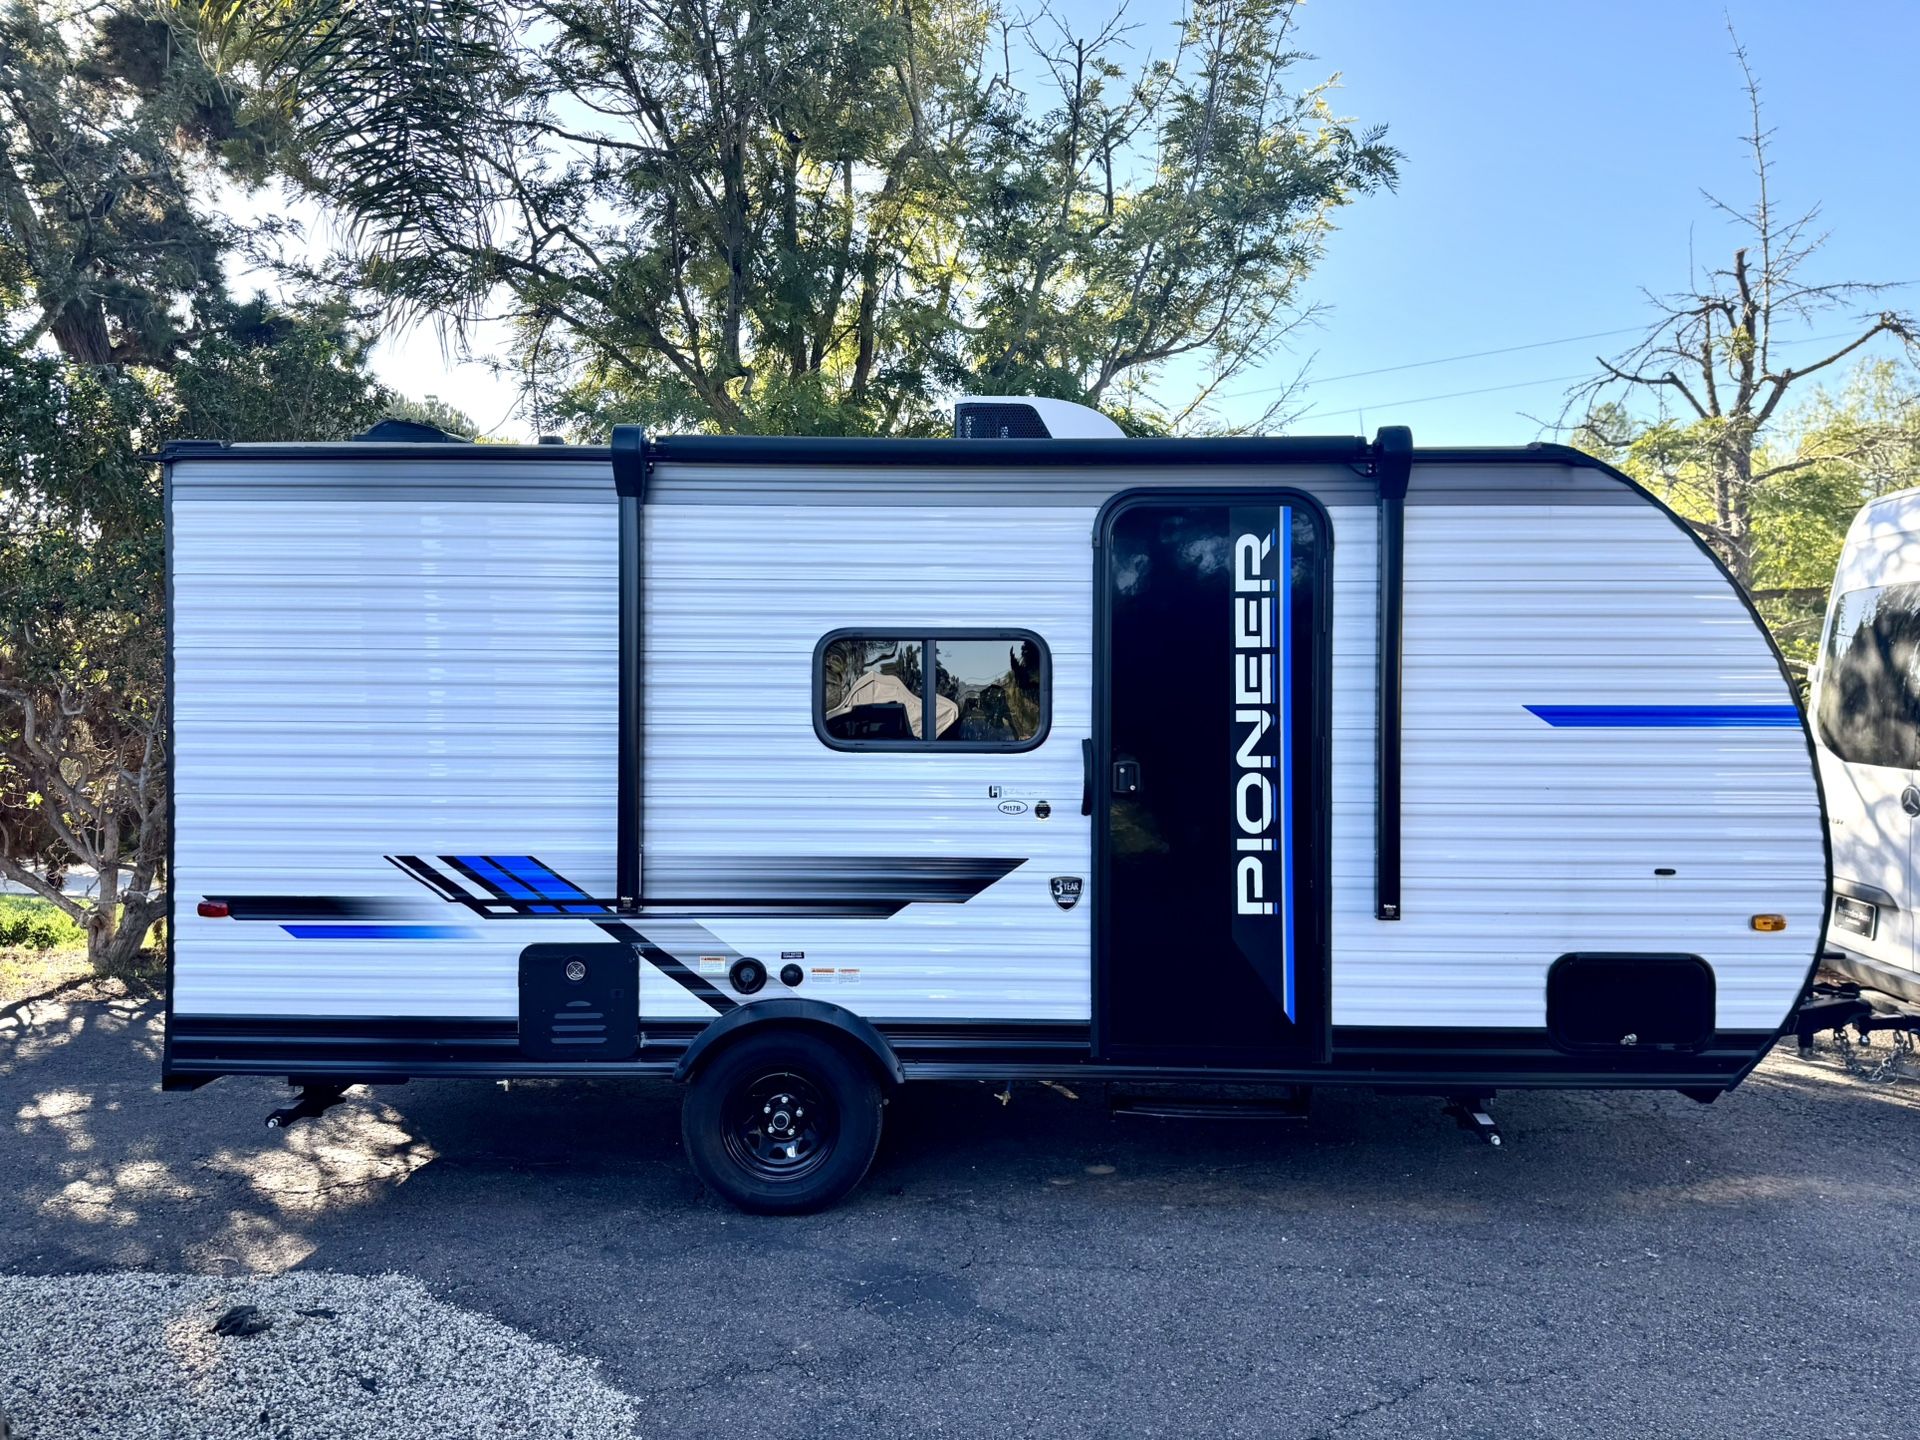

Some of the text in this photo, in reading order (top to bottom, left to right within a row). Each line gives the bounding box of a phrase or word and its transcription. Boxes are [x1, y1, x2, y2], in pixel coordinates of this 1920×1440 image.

[1235, 532, 1275, 915] PIONEER
[1054, 879, 1079, 895] 3 YEAR
